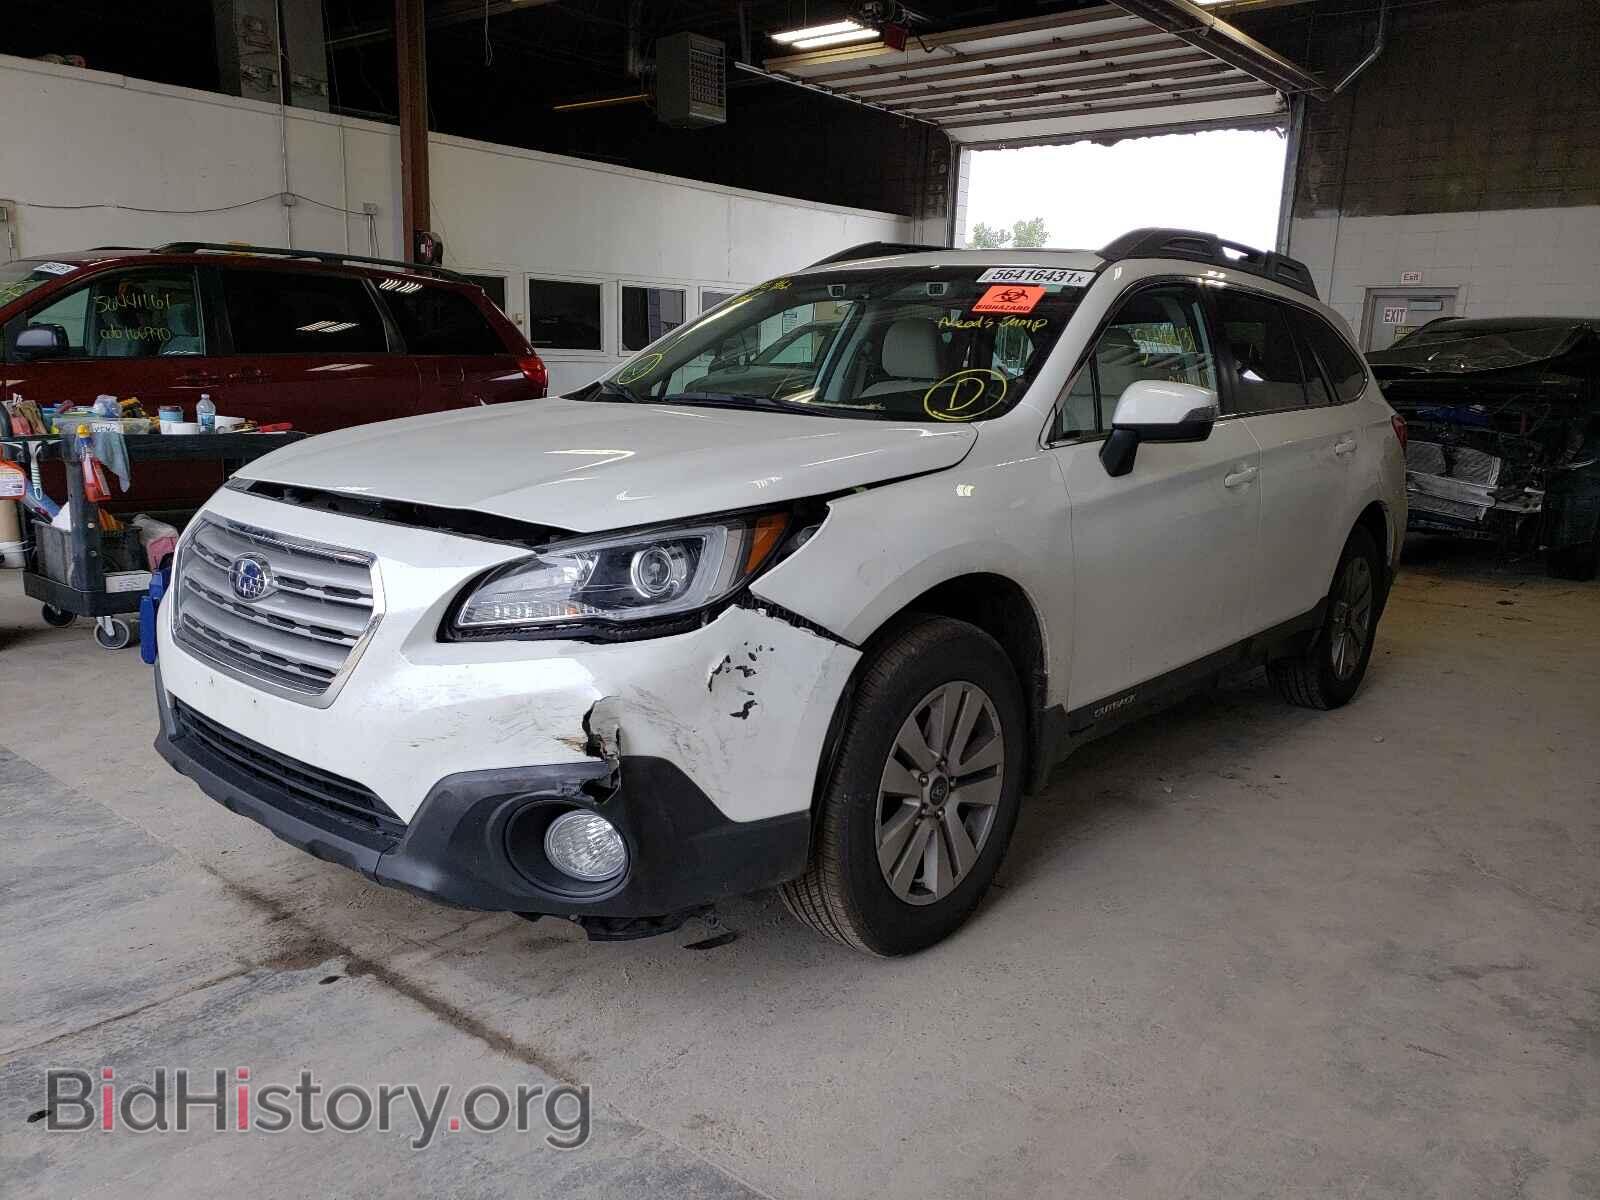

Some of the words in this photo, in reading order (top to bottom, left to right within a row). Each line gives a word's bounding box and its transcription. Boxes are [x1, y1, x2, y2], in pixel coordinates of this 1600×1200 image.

[975, 303, 1031, 311] BIOHAZARD
[1384, 308, 1405, 322] EXIT
[945, 377, 985, 411] D
